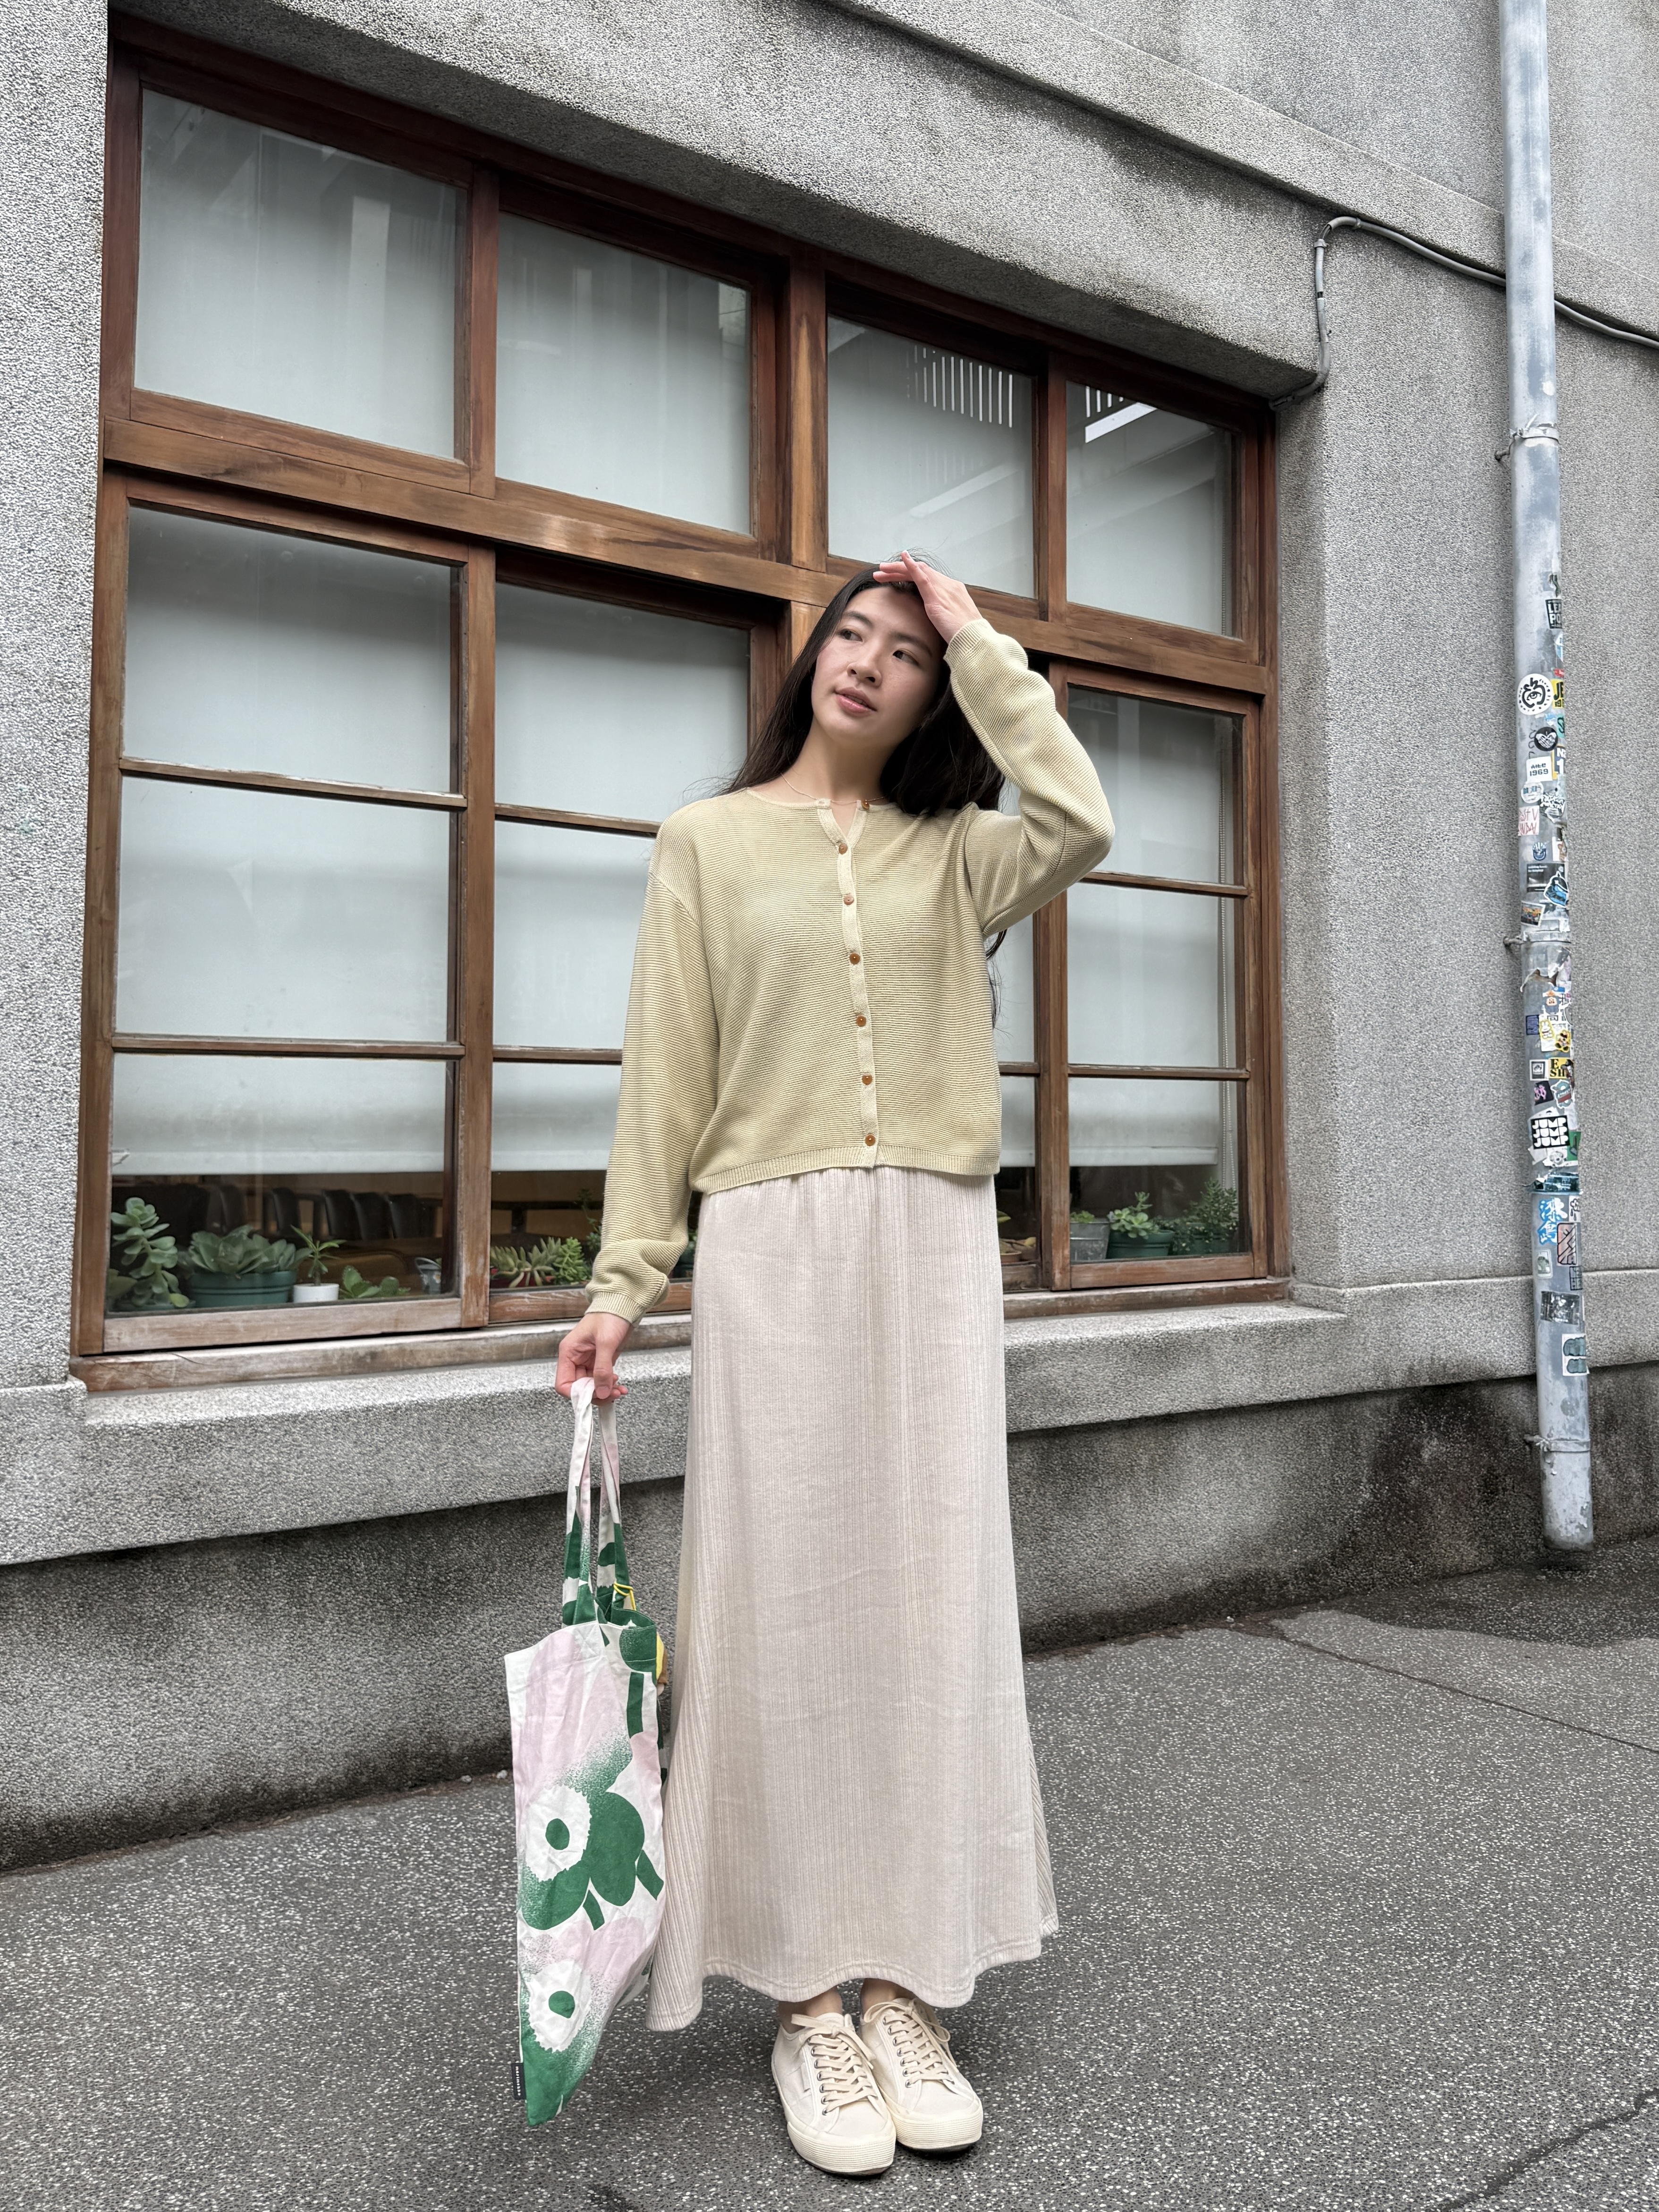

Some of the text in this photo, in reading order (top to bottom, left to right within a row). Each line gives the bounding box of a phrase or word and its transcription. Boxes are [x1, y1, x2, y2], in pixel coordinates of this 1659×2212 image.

[1532, 1118, 1566, 1129] JUMP
[1533, 1127, 1567, 1138] JUMP
[1534, 1135, 1568, 1147] JUMP
